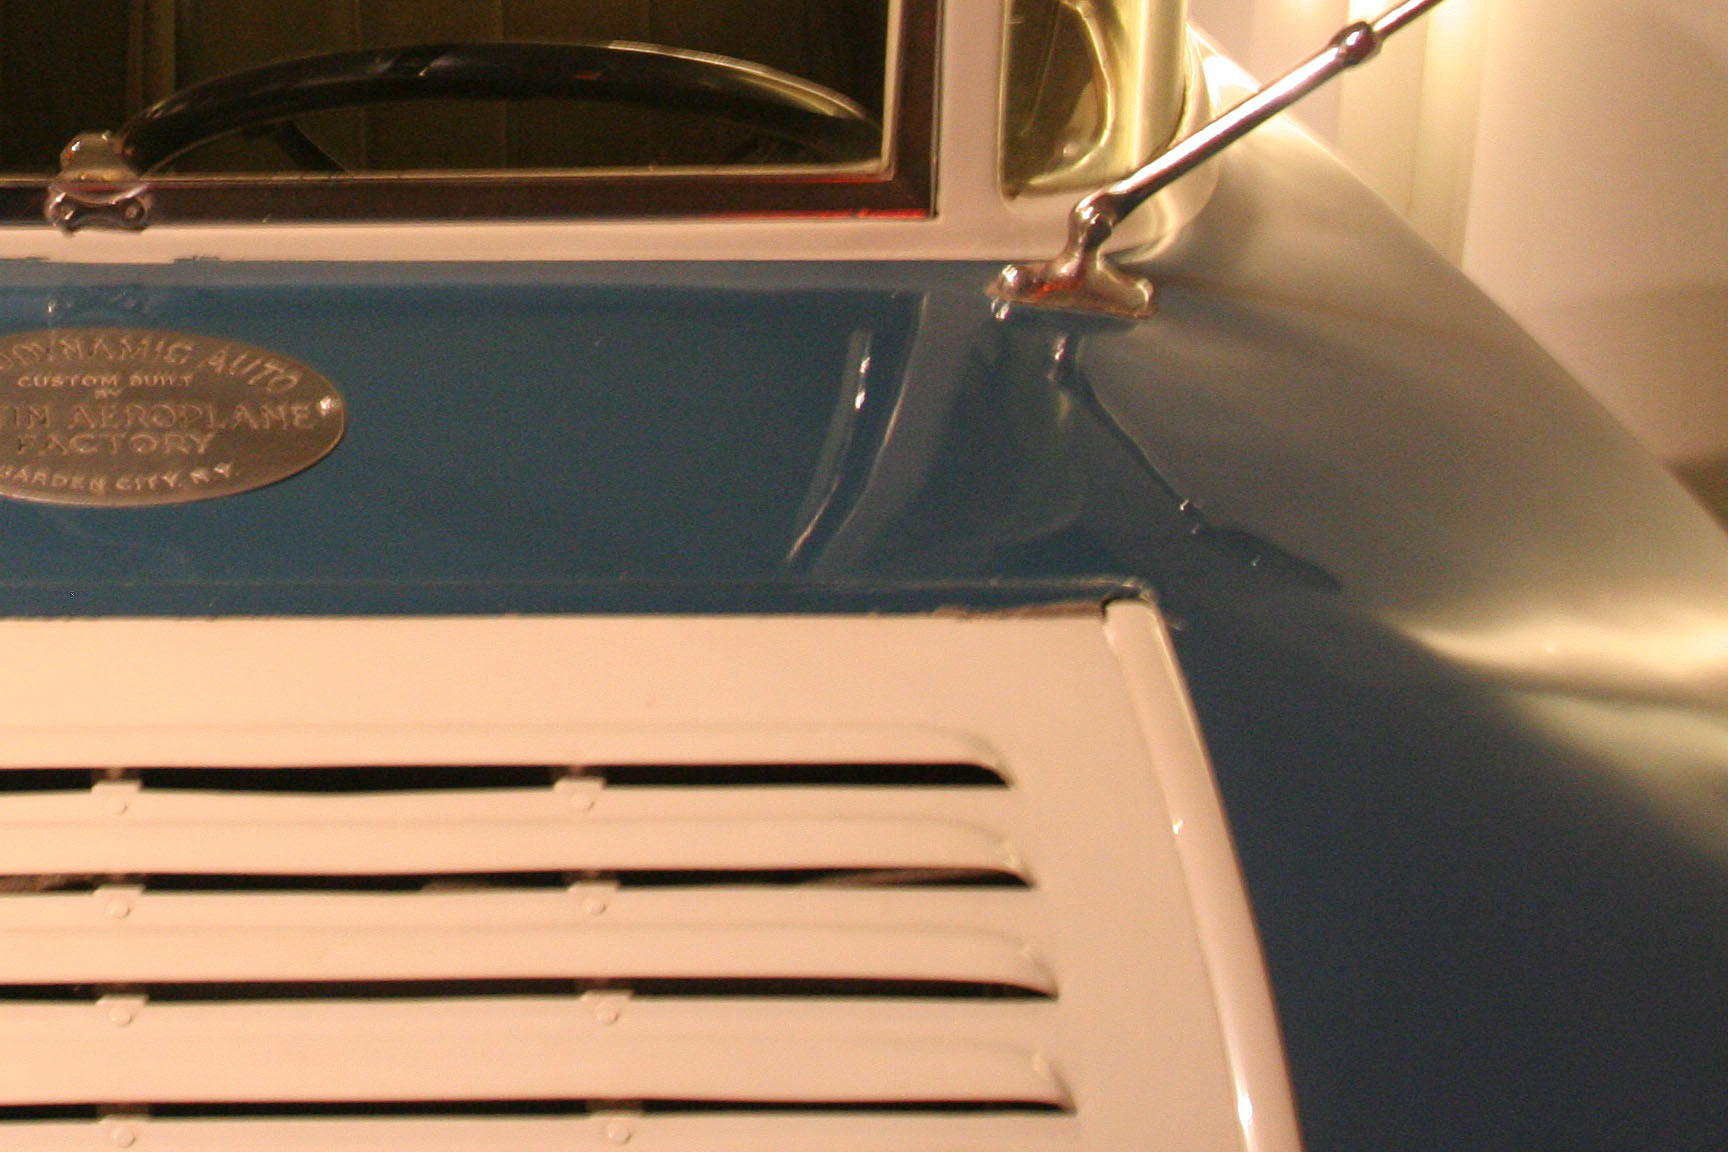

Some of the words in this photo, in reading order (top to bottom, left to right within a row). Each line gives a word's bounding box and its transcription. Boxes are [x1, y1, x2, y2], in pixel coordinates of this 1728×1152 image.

[16, 373, 119, 389] CUSTOM
[129, 373, 194, 388] BUILT
[198, 346, 301, 395] AUTO
[67, 401, 317, 430] AEROPLANE
[16, 433, 215, 456] FACTORY
